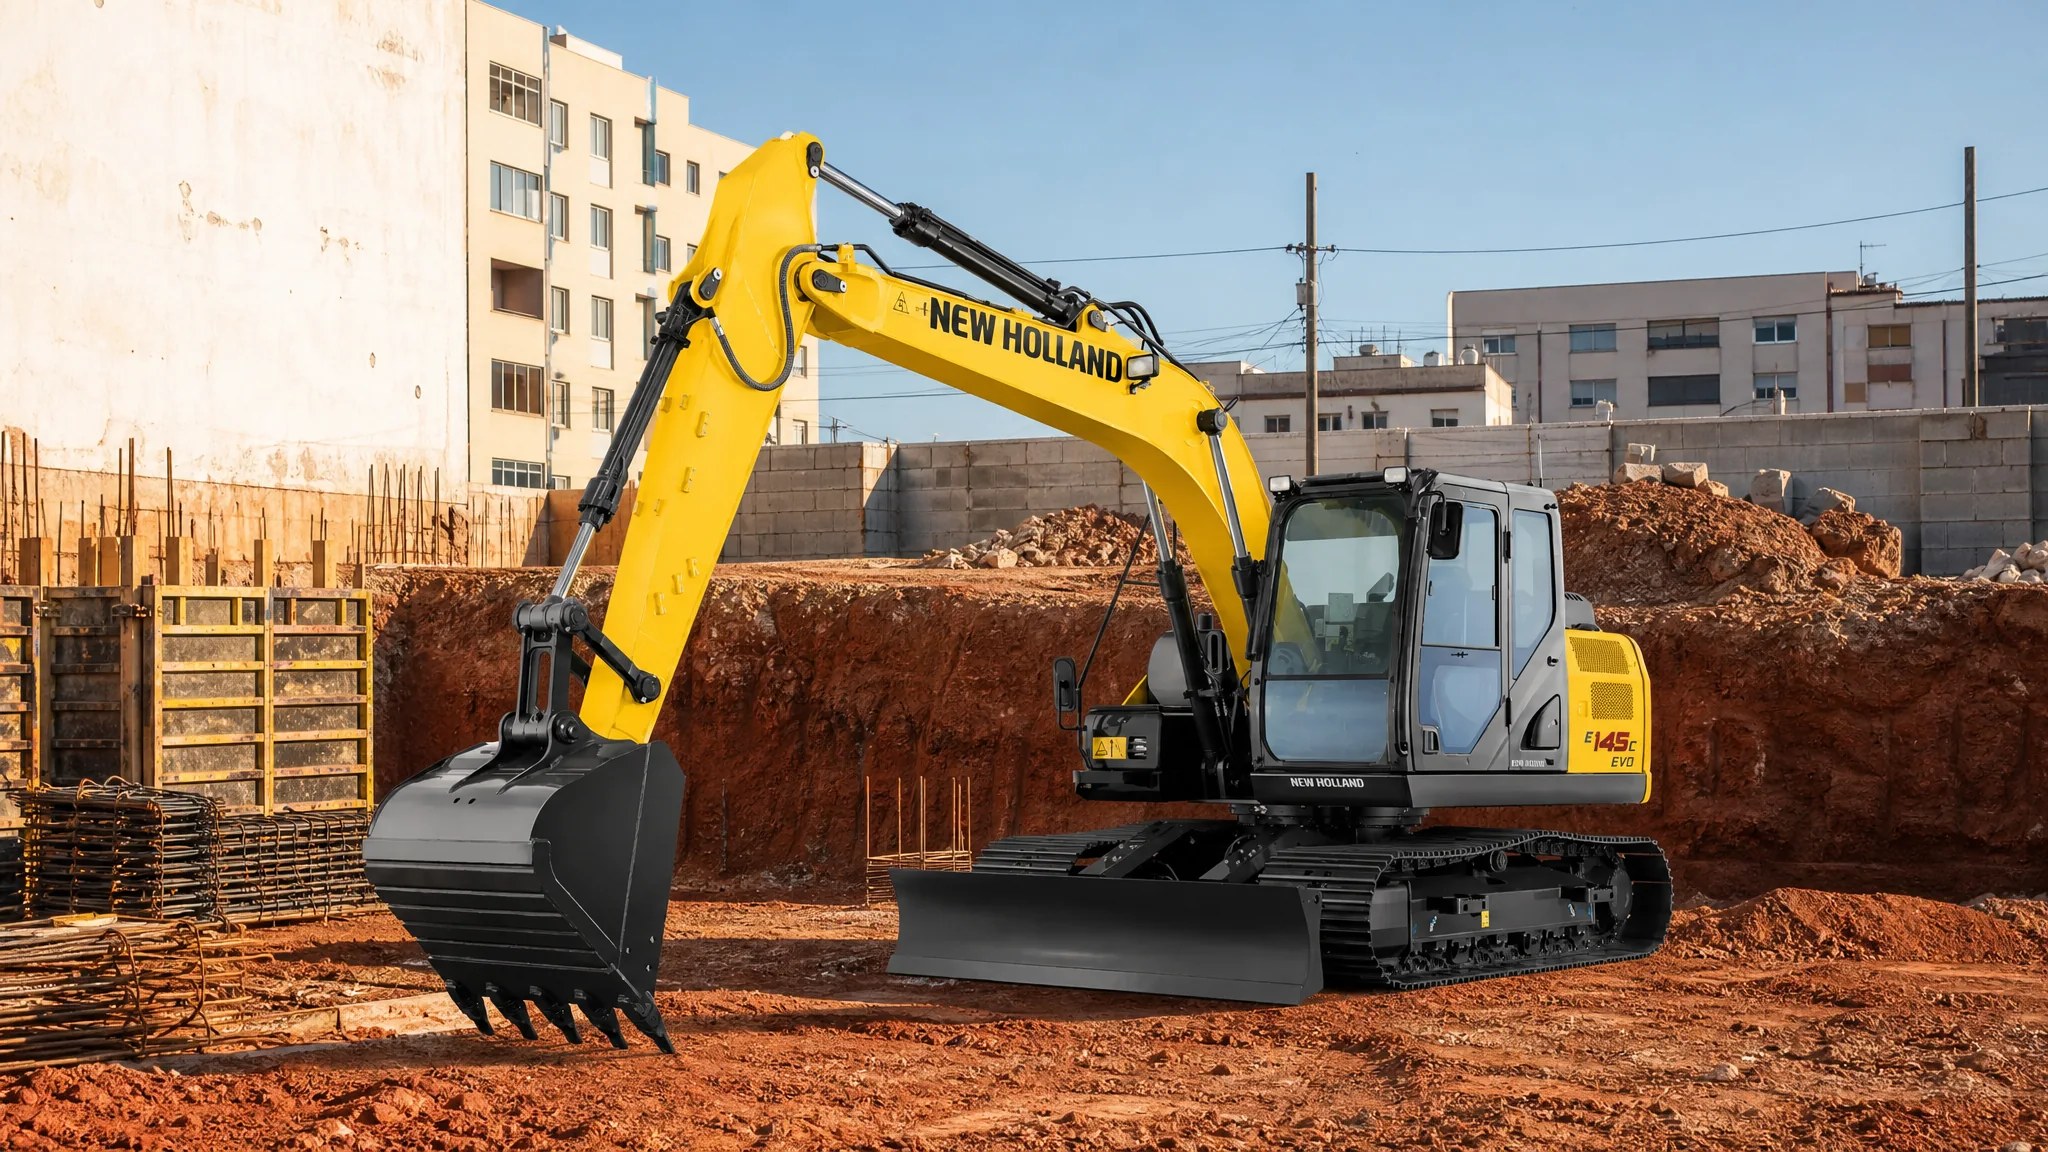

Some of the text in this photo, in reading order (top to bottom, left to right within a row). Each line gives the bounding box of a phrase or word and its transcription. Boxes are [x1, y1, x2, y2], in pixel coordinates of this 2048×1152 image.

[930, 297, 1123, 383] NEW HOLLAND
[1611, 756, 1635, 768] EVO
[1290, 777, 1365, 788] NEW HOLLAND
